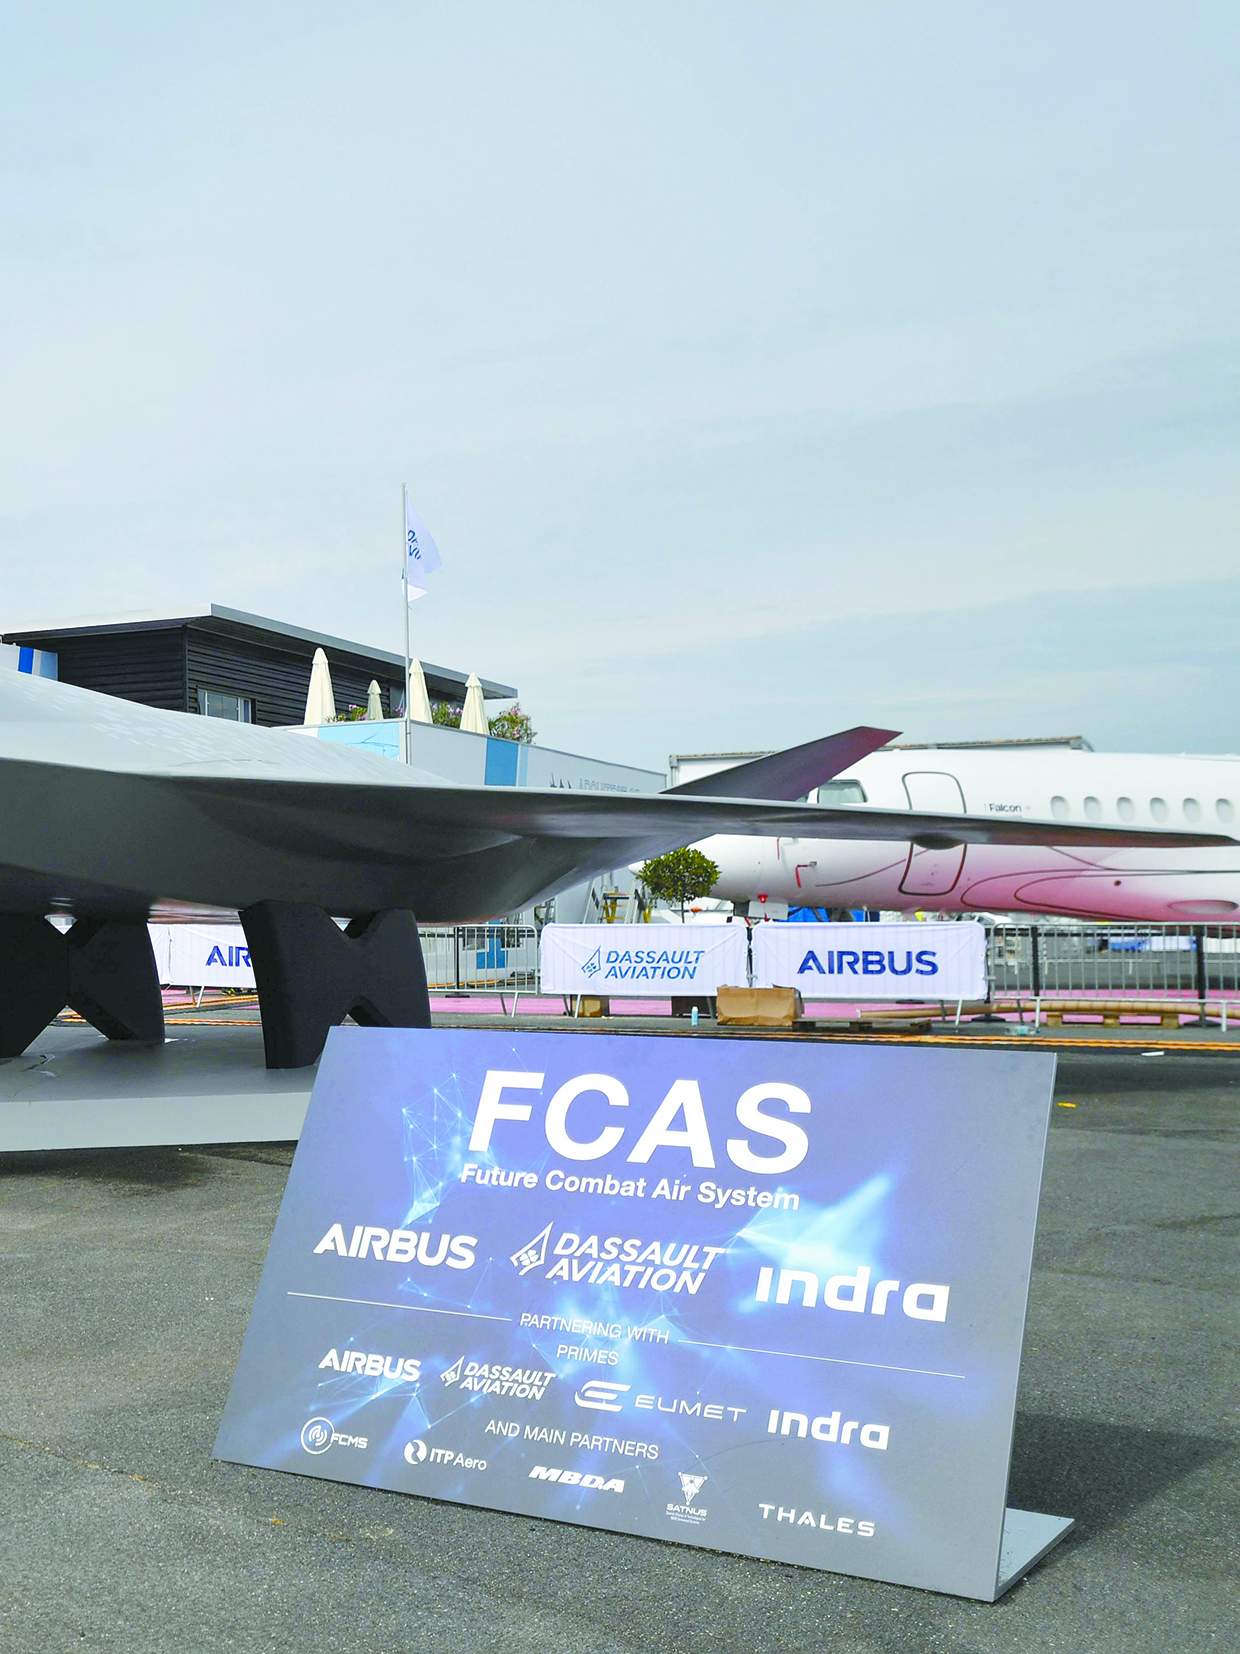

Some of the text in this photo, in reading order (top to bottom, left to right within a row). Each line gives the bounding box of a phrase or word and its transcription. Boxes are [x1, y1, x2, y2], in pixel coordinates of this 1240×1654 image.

[989, 803, 1022, 813] Falcon
[605, 950, 705, 965] DASSAULT
[605, 965, 698, 980] AVIATION
[797, 949, 939, 976] AIRBUS
[468, 1069, 812, 1175] FCAS
[460, 1163, 801, 1211] Future Combat Air System
[313, 1223, 479, 1270] AIRBUS
[553, 1231, 727, 1271] DASSAULT
[545, 1257, 709, 1296] AVIATION
[755, 1265, 951, 1323] indra
[519, 1312, 671, 1345] PARTNERING WITH
[318, 1348, 421, 1382] AIRBUS
[556, 1344, 620, 1366] PRIMES
[459, 1375, 546, 1401] AVIATION
[463, 1361, 558, 1387] DASSAULT
[635, 1394, 747, 1422] EUMET
[330, 1433, 368, 1449] FCMS
[484, 1419, 659, 1461] AND MAIN PARTNERS
[767, 1409, 891, 1451] indra
[528, 1465, 626, 1494] MBDA
[666, 1503, 708, 1517] SATNUS
[758, 1502, 876, 1538] THALES
